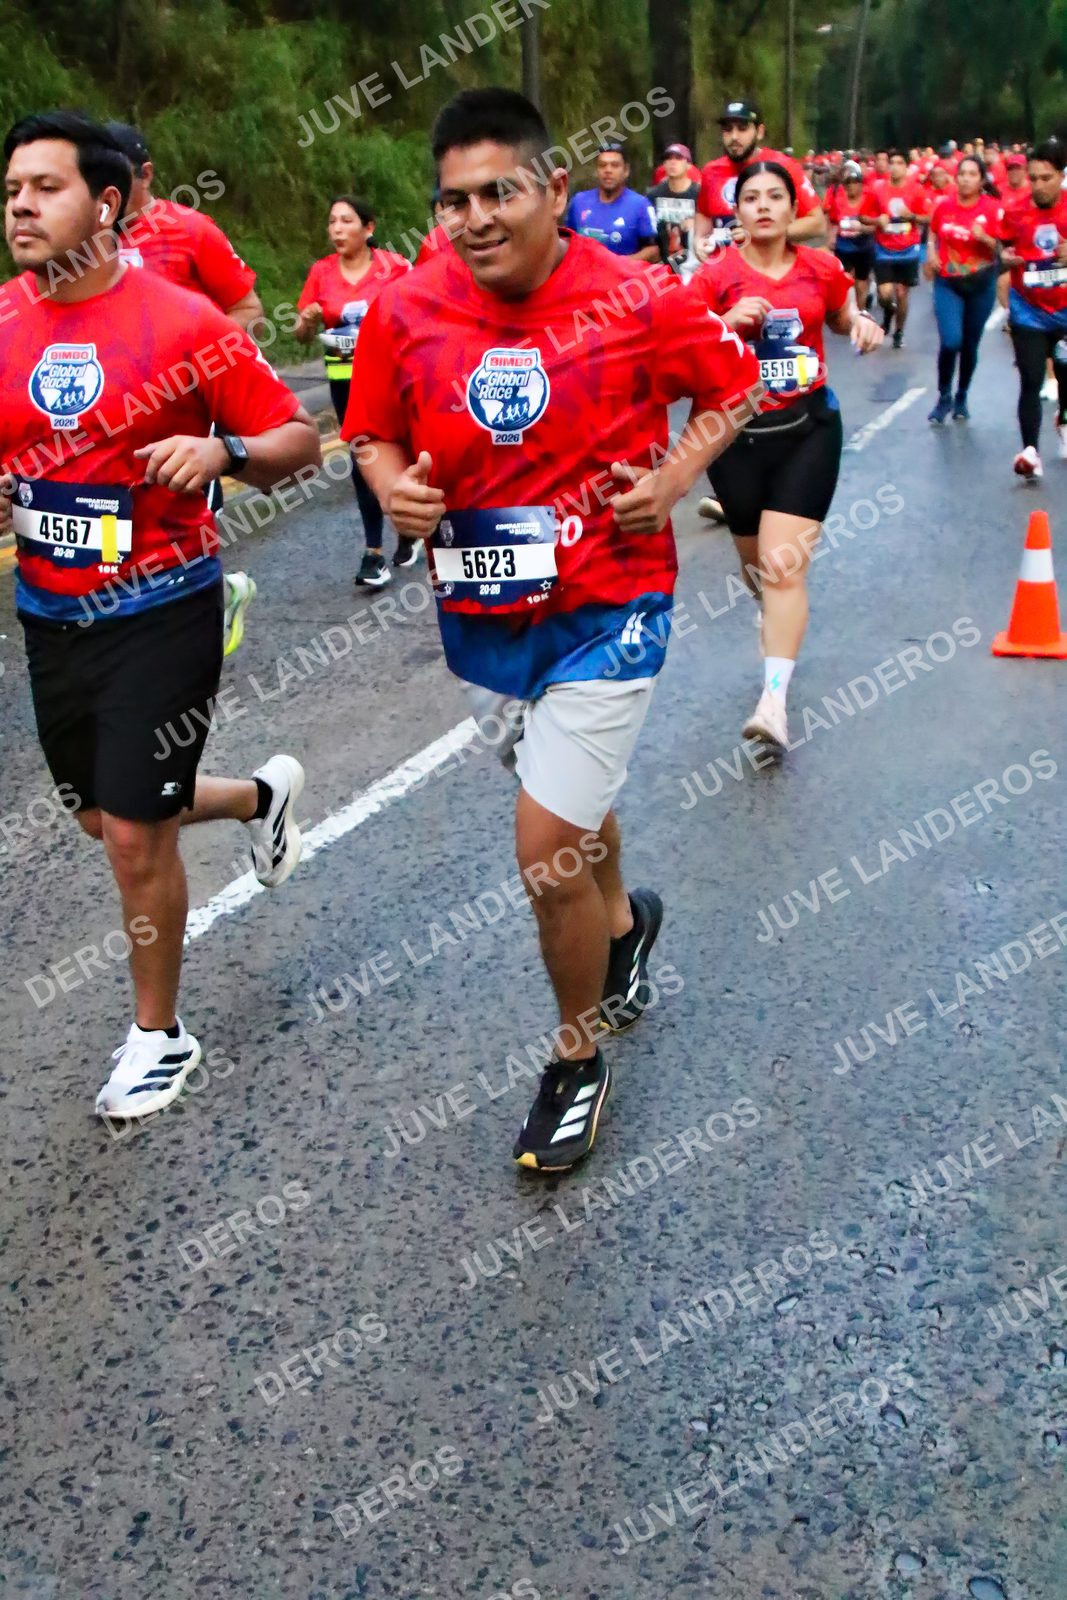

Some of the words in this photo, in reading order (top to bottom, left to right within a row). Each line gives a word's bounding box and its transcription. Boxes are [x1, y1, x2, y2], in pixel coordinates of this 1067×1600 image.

[50, 351, 89, 360] BIMBO
[489, 356, 533, 367] BIMBO
[49, 364, 87, 378] Global
[761, 360, 794, 379] 5519
[39, 376, 71, 389] Race
[487, 371, 531, 387] Global
[478, 384, 513, 399] Race
[54, 418, 75, 427] 2026
[495, 433, 521, 443] 2026
[39, 514, 92, 546] 4567
[98, 565, 119, 574] 10K
[461, 548, 517, 579] 5623
[527, 592, 550, 605] 10K
